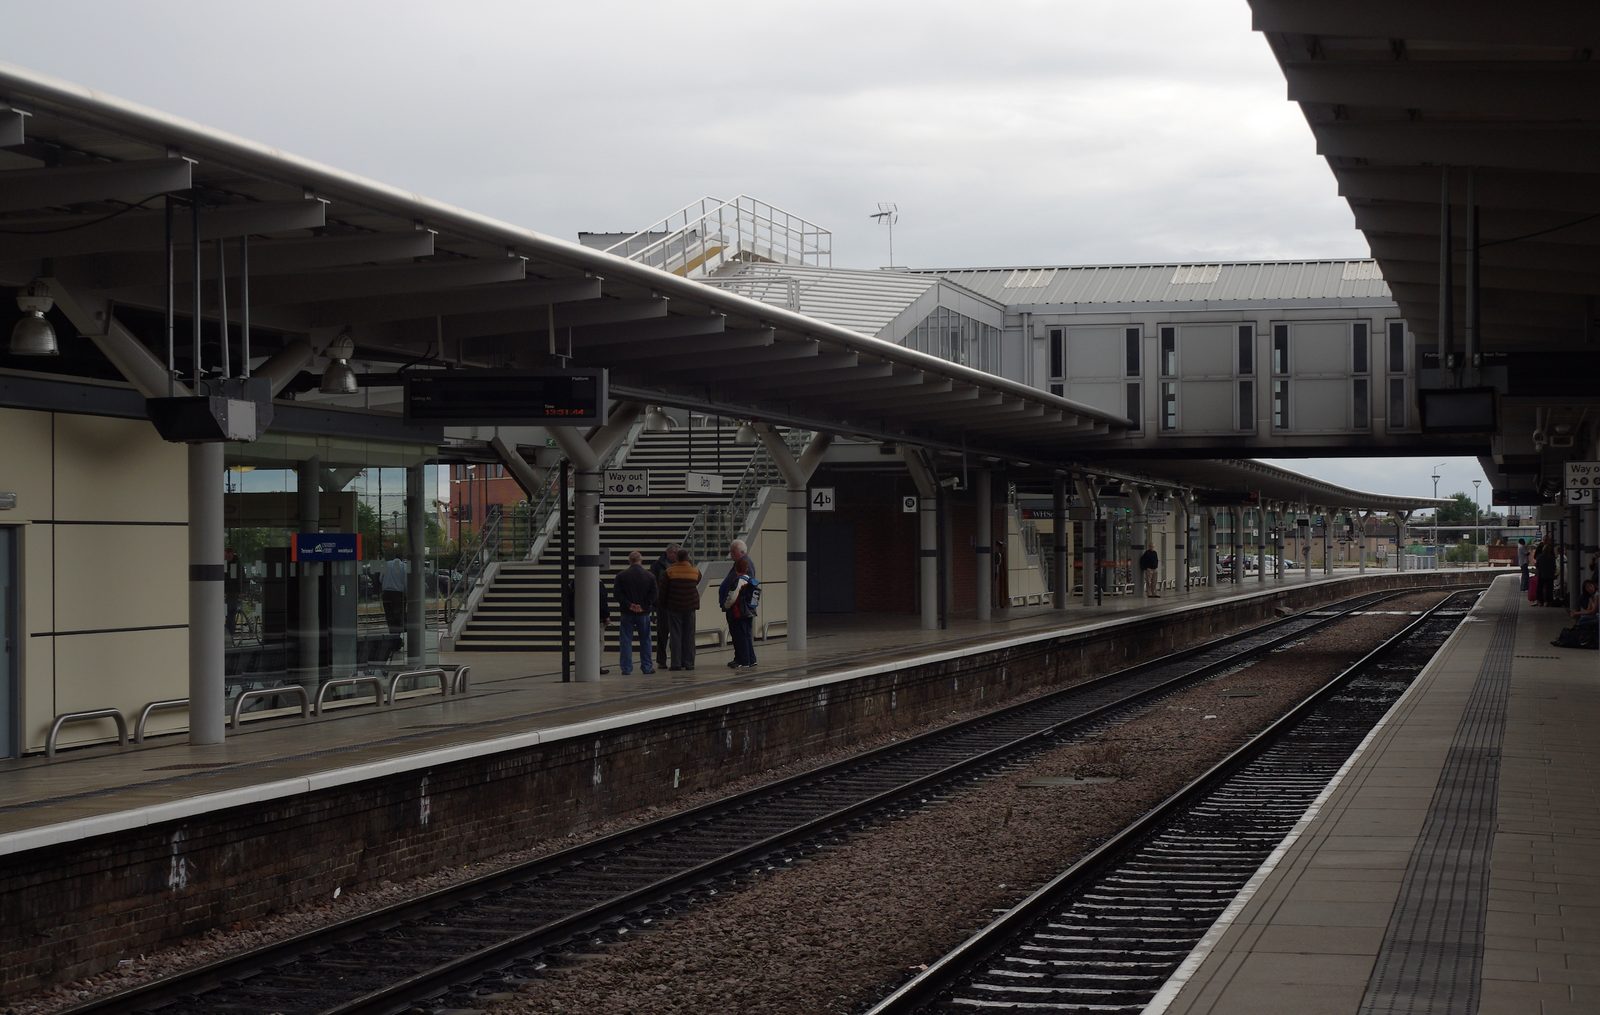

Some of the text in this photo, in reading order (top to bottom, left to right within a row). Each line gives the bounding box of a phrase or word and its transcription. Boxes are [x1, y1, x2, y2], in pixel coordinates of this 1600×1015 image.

[1571, 464, 1591, 475] Way
[608, 472, 643, 482] Way out
[813, 491, 832, 507] 4b
